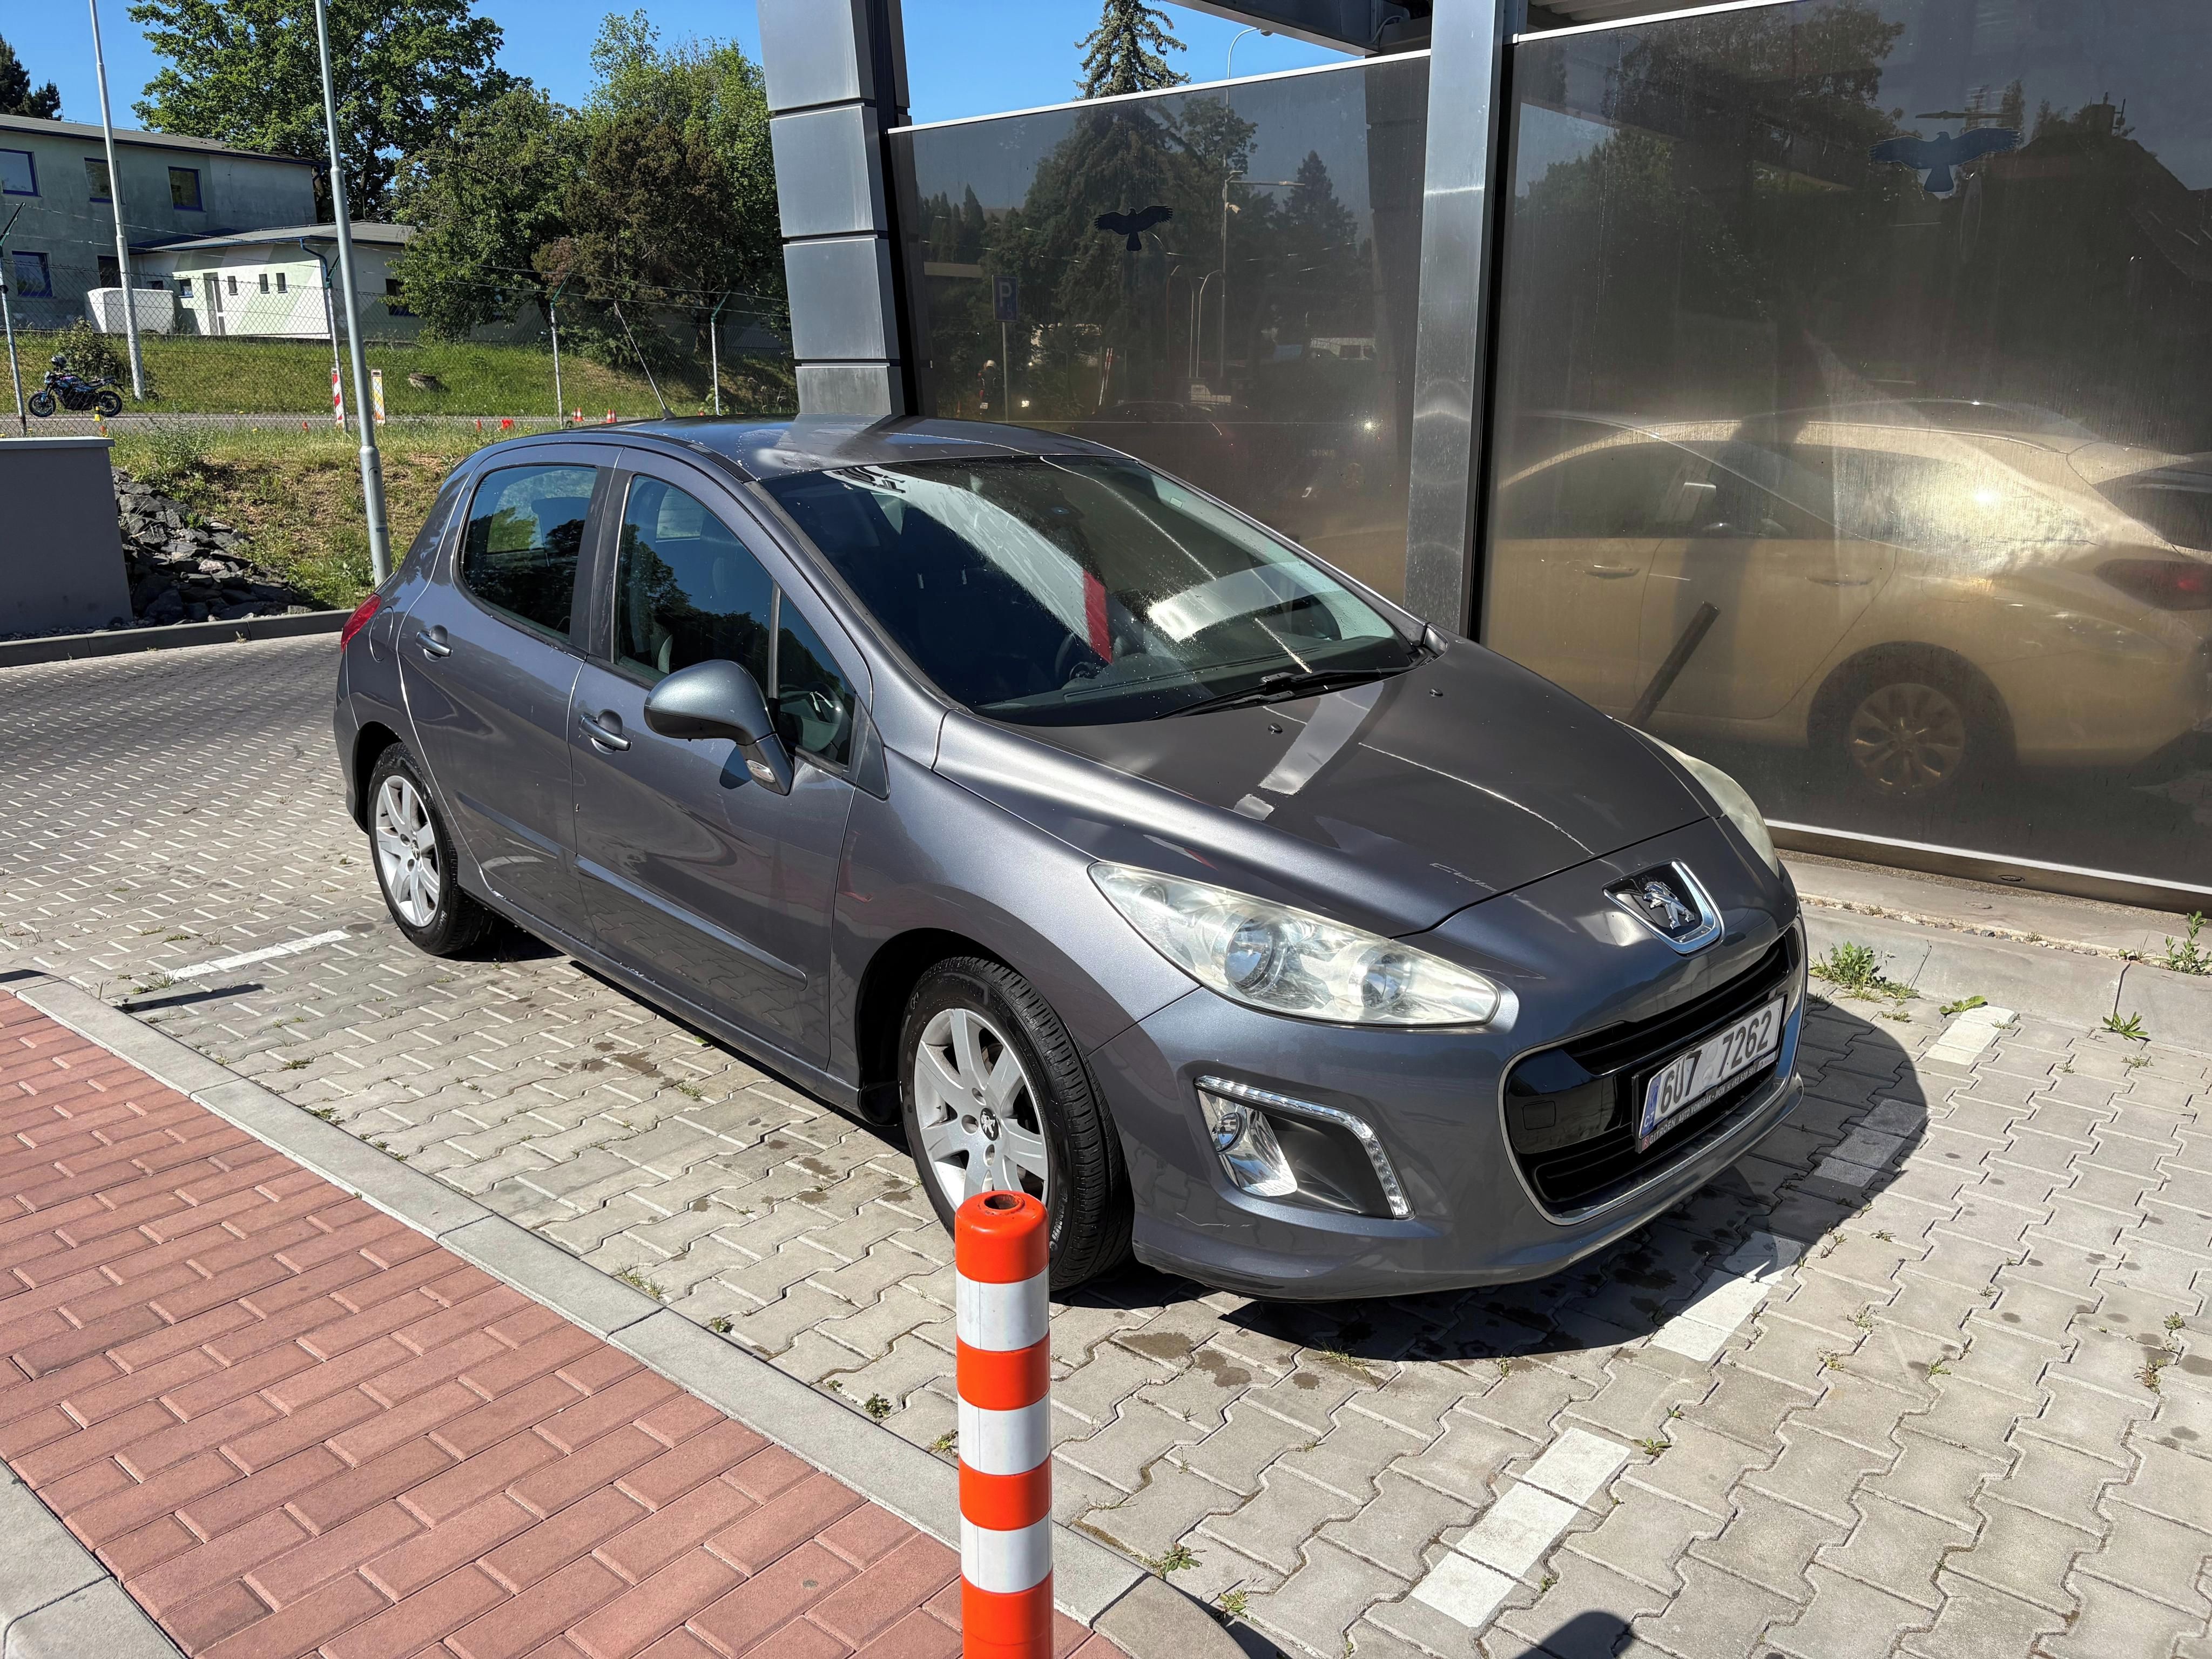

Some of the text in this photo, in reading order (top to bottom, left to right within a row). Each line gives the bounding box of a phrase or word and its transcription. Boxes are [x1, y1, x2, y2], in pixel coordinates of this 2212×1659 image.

[999, 281, 1012, 307] P
[1661, 1011, 1772, 1114] 6U7 7262
[1644, 1111, 1655, 1128] CZ
[1649, 1118, 1676, 1144] CITROËN
[1678, 1109, 1690, 1123] AUTO
